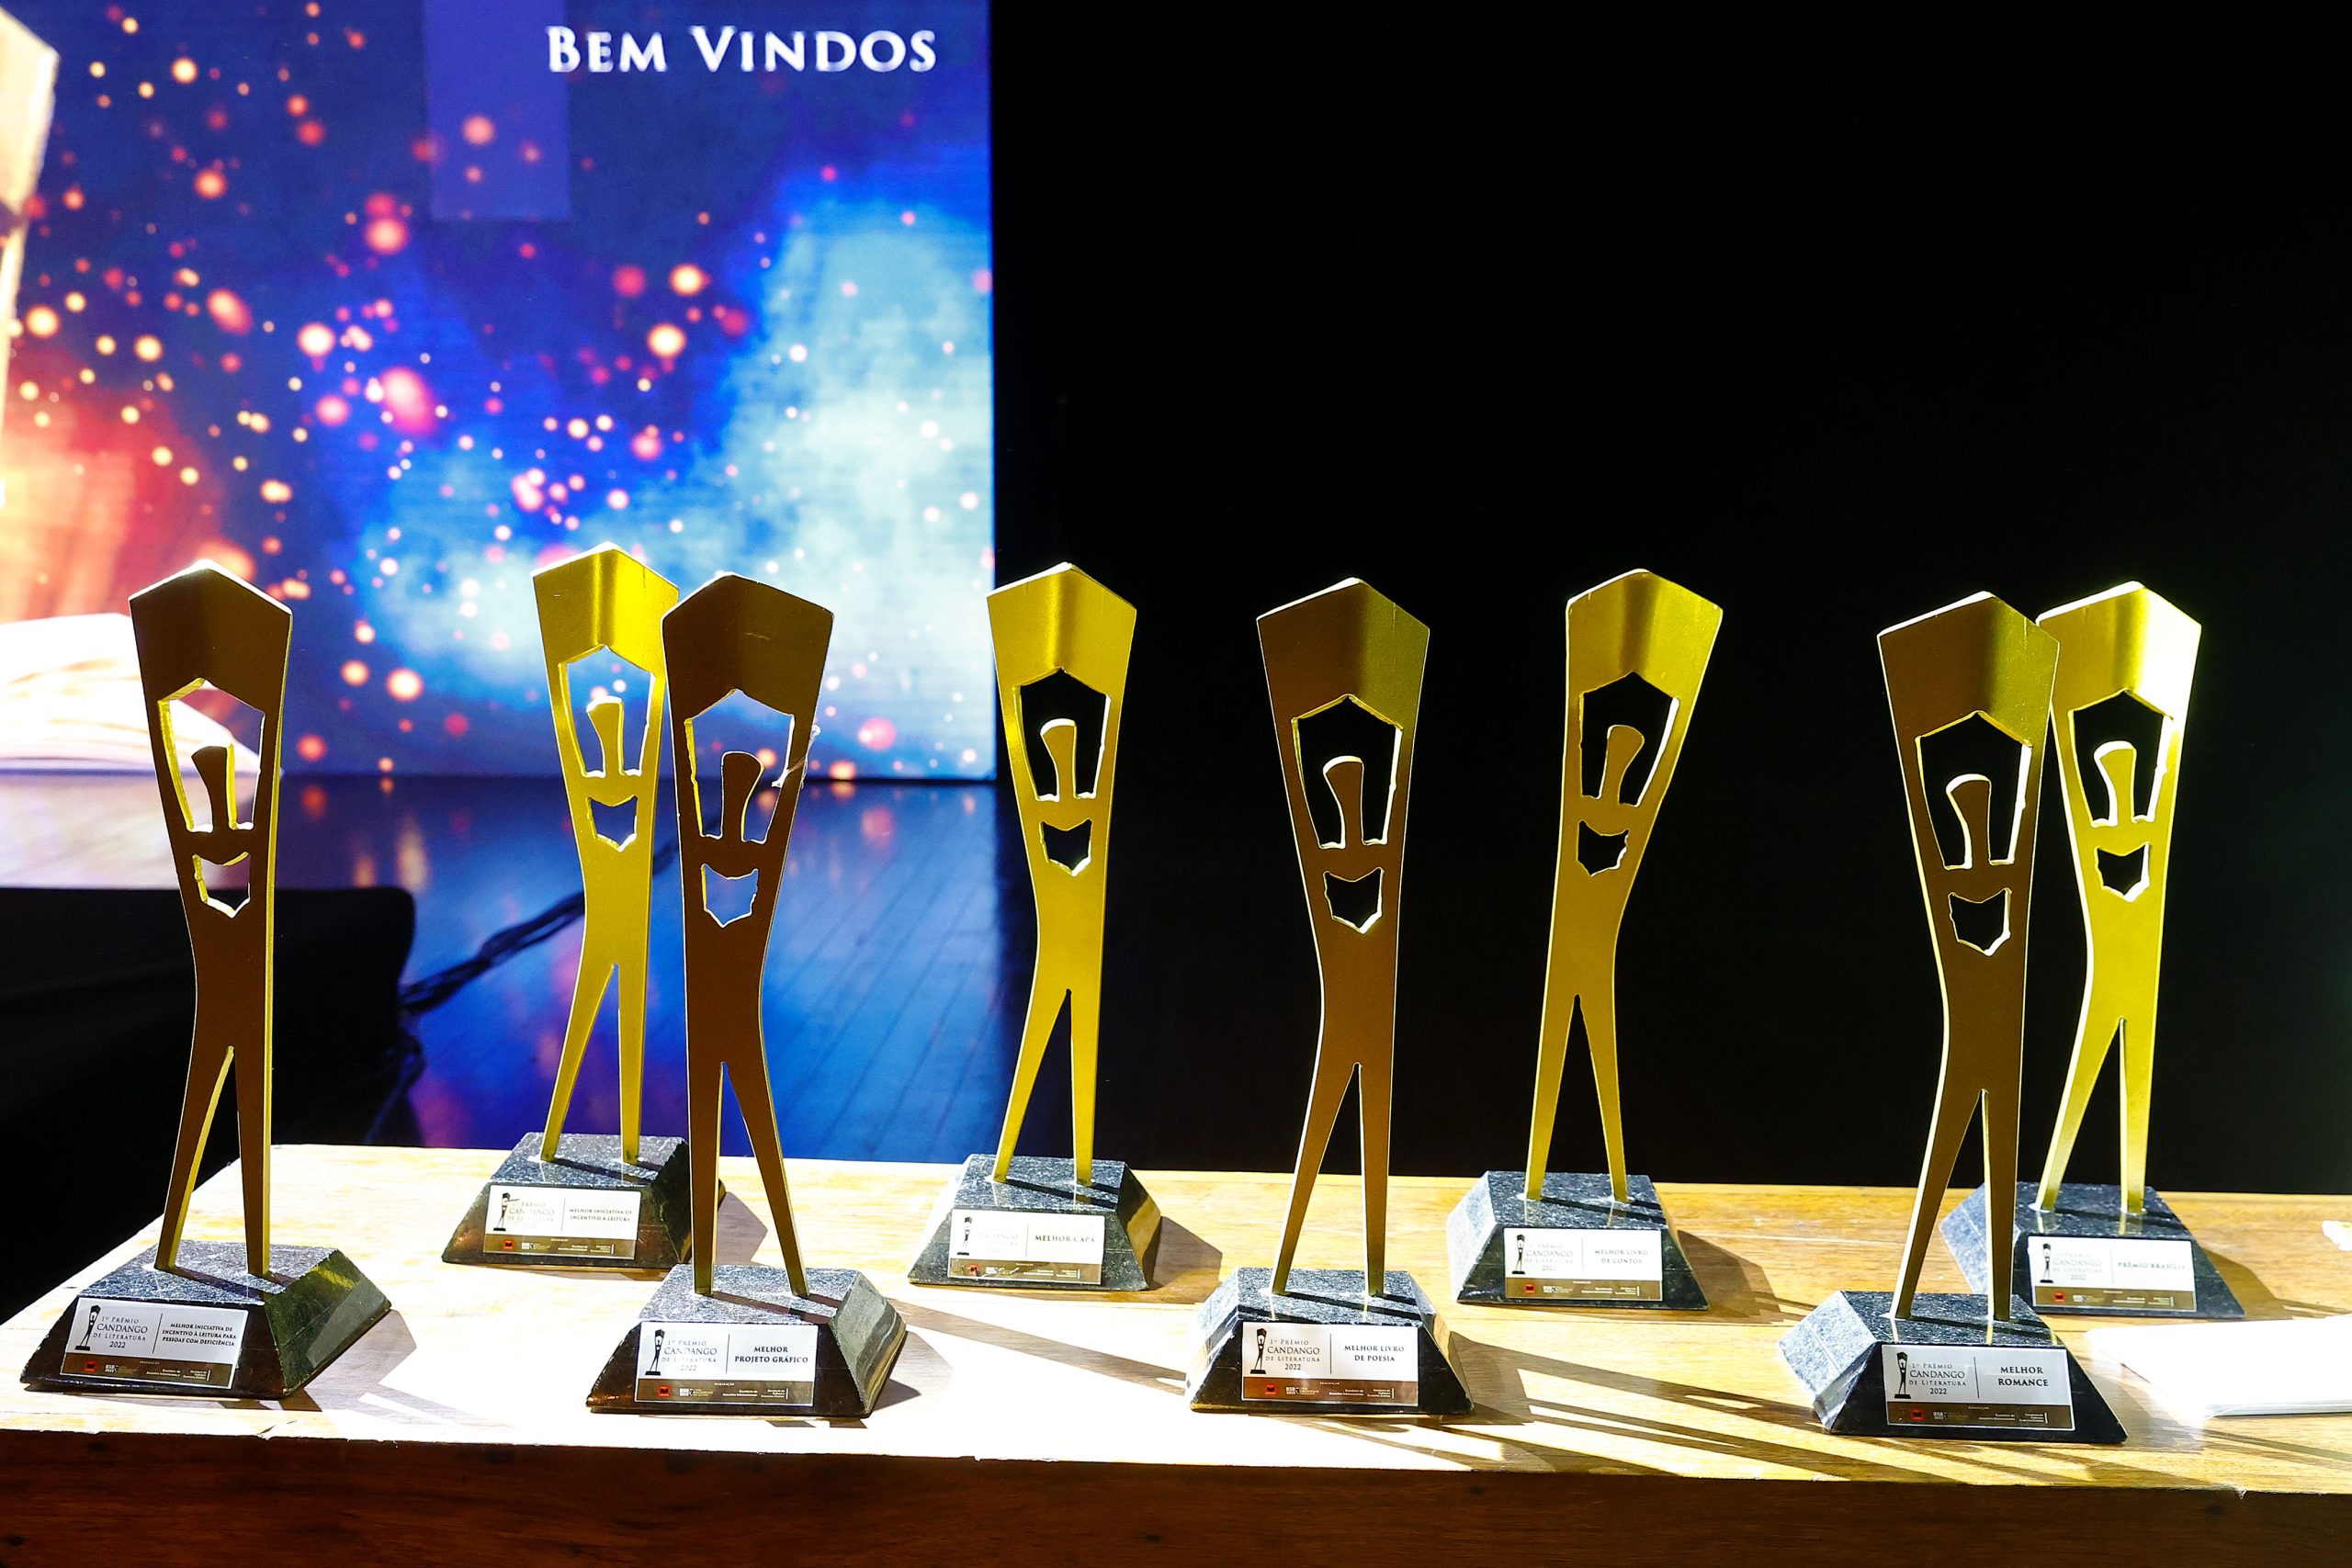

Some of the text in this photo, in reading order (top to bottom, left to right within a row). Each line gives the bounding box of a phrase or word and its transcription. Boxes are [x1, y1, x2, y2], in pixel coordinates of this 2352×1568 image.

[547, 25, 936, 73] BEM VINDOS
[96, 1323, 148, 1334] CANDANGO
[105, 1333, 145, 1341] LITERATURA
[1267, 1346, 1320, 1355] CANDANGO
[772, 1355, 808, 1363] GRÁFICO
[1910, 1370, 1965, 1378] CANDANGO
[2000, 1366, 2043, 1374] MELHOR
[1998, 1378, 2049, 1386] ROMANCE
